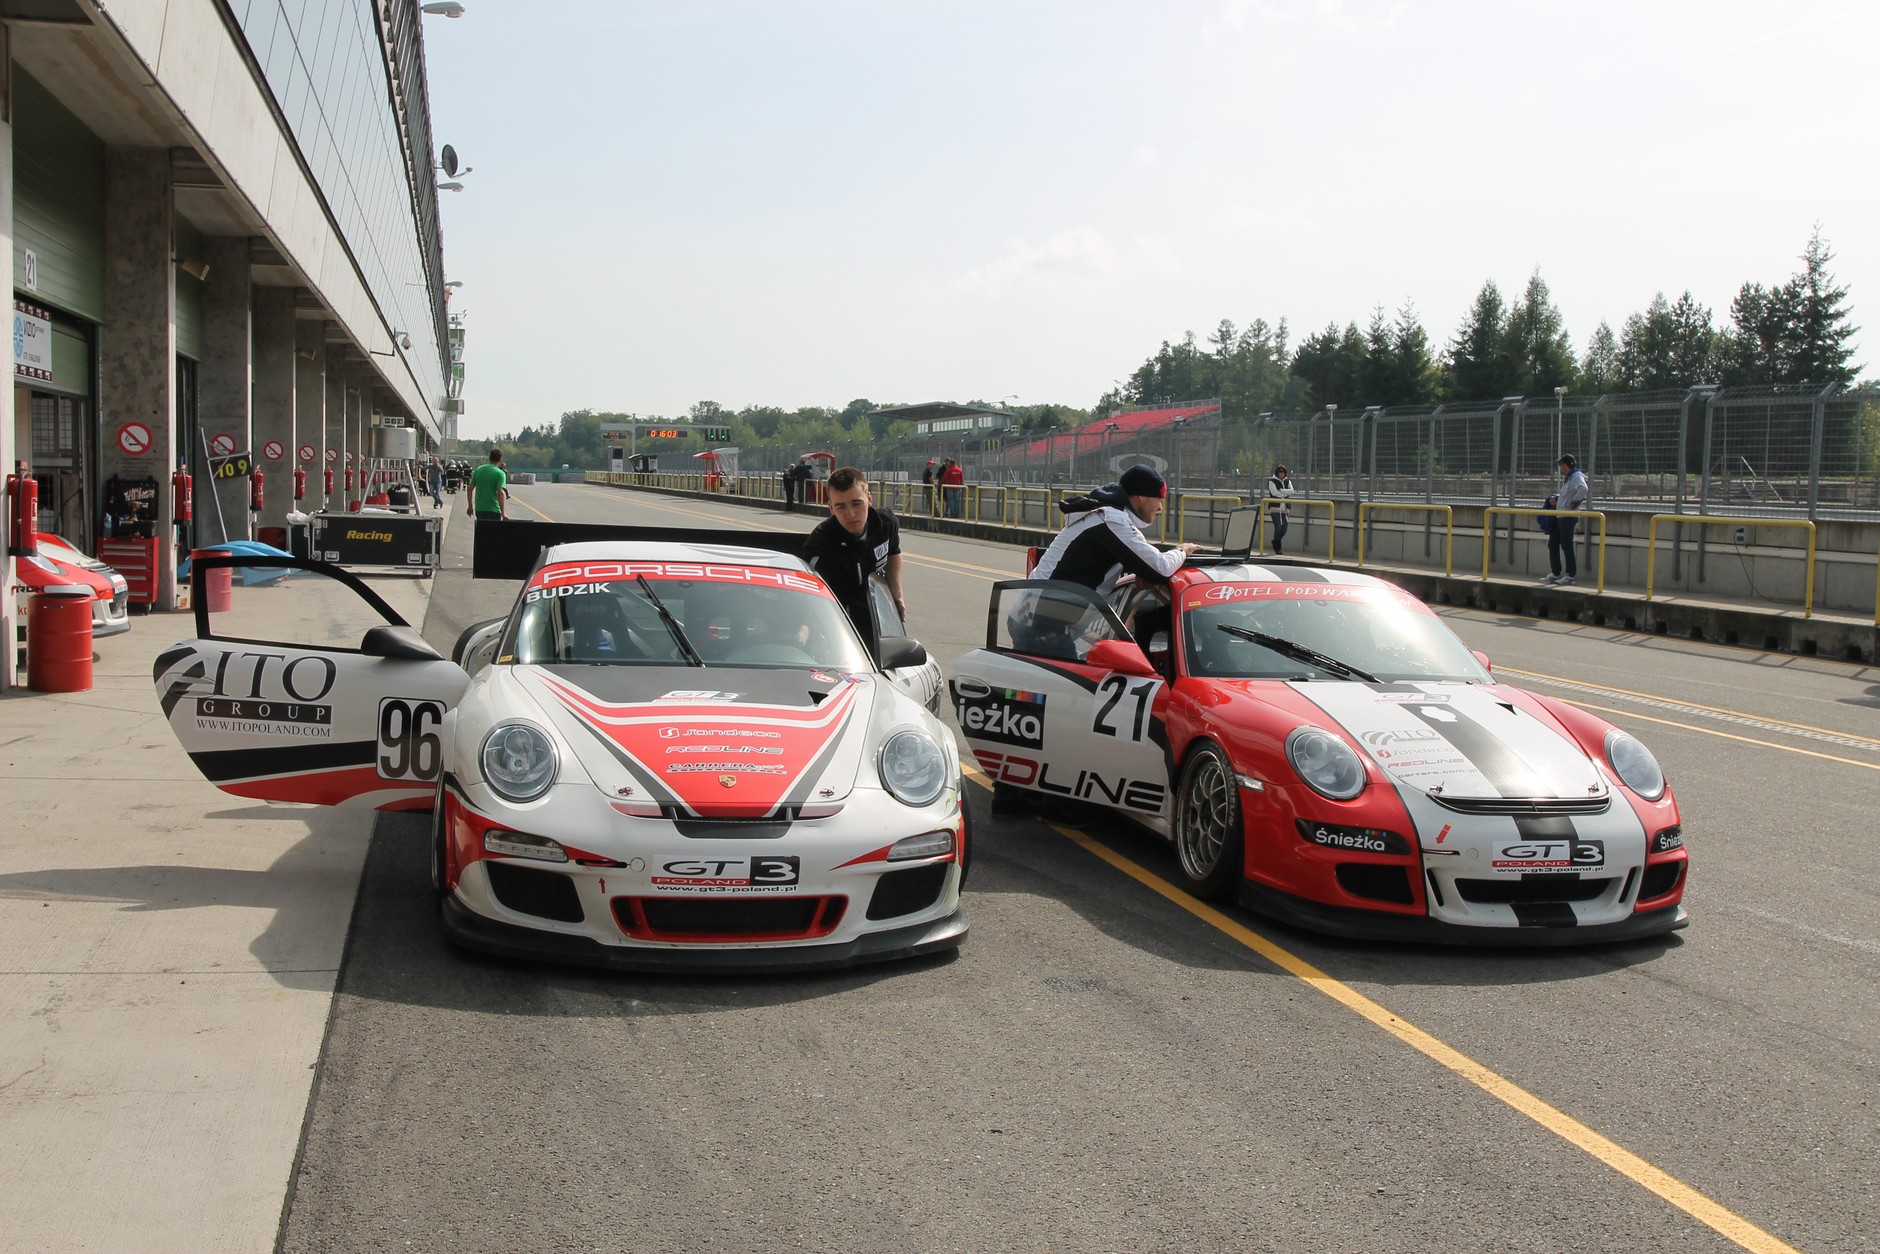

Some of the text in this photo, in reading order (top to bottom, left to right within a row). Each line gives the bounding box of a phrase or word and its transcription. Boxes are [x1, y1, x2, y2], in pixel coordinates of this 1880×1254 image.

[26, 253, 35, 287] 21
[346, 530, 393, 542] Racing
[543, 564, 821, 593] PORSCHE
[526, 582, 611, 604] BUDZIK
[1285, 587, 1318, 596] POD
[212, 650, 337, 702] ITO
[202, 701, 326, 719] GROUP
[1092, 675, 1156, 742] 21
[196, 719, 331, 738] WWW.ITOPOLAND.COM
[380, 699, 443, 780] 96
[665, 745, 784, 755] REDLINE
[1387, 758, 1465, 769] REDLINE
[1315, 827, 1386, 851] Śnieżka
[1501, 844, 1604, 862] GT 3
[662, 860, 797, 882] GT 3
[656, 885, 797, 893] www.gt3-poland.pl
